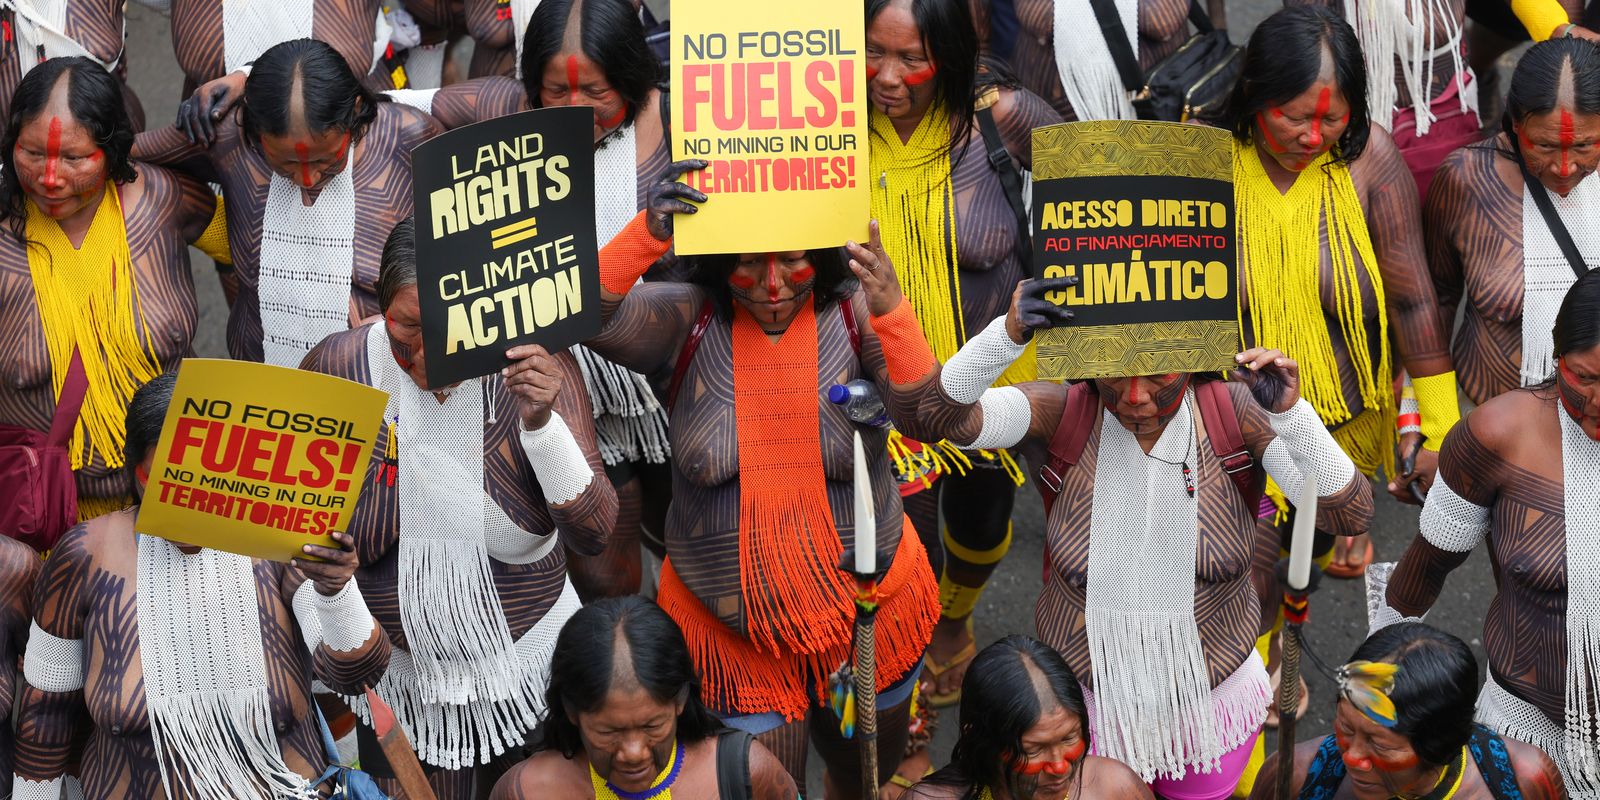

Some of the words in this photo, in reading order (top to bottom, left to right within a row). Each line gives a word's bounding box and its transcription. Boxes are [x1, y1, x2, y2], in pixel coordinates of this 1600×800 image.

[684, 33, 727, 60] NO
[738, 29, 856, 58] FOSSIL
[682, 60, 856, 132] FUELS!
[451, 133, 544, 180] LAND
[684, 138, 711, 155] NO
[717, 136, 784, 154] MINING
[790, 135, 808, 152] IN
[815, 134, 857, 151] OUR
[430, 154, 571, 240] RIGHTS
[1041, 199, 1133, 230] ACESSO
[1141, 199, 1227, 228] DIRETO
[438, 234, 577, 301] CLIMATE
[1045, 237, 1071, 251] AO
[1076, 234, 1226, 250] FINANCIAMENTO
[1043, 249, 1228, 306] CLIMÁTICO
[446, 265, 582, 355] ACTION
[182, 397, 232, 420] NO
[241, 404, 367, 443] FOSSIL
[168, 417, 362, 492] FUELS!
[159, 481, 339, 536] TERRITORIES!
[164, 467, 194, 483] NO
[200, 474, 270, 498] MINING
[275, 488, 296, 503] IN
[301, 492, 345, 508] OUR
